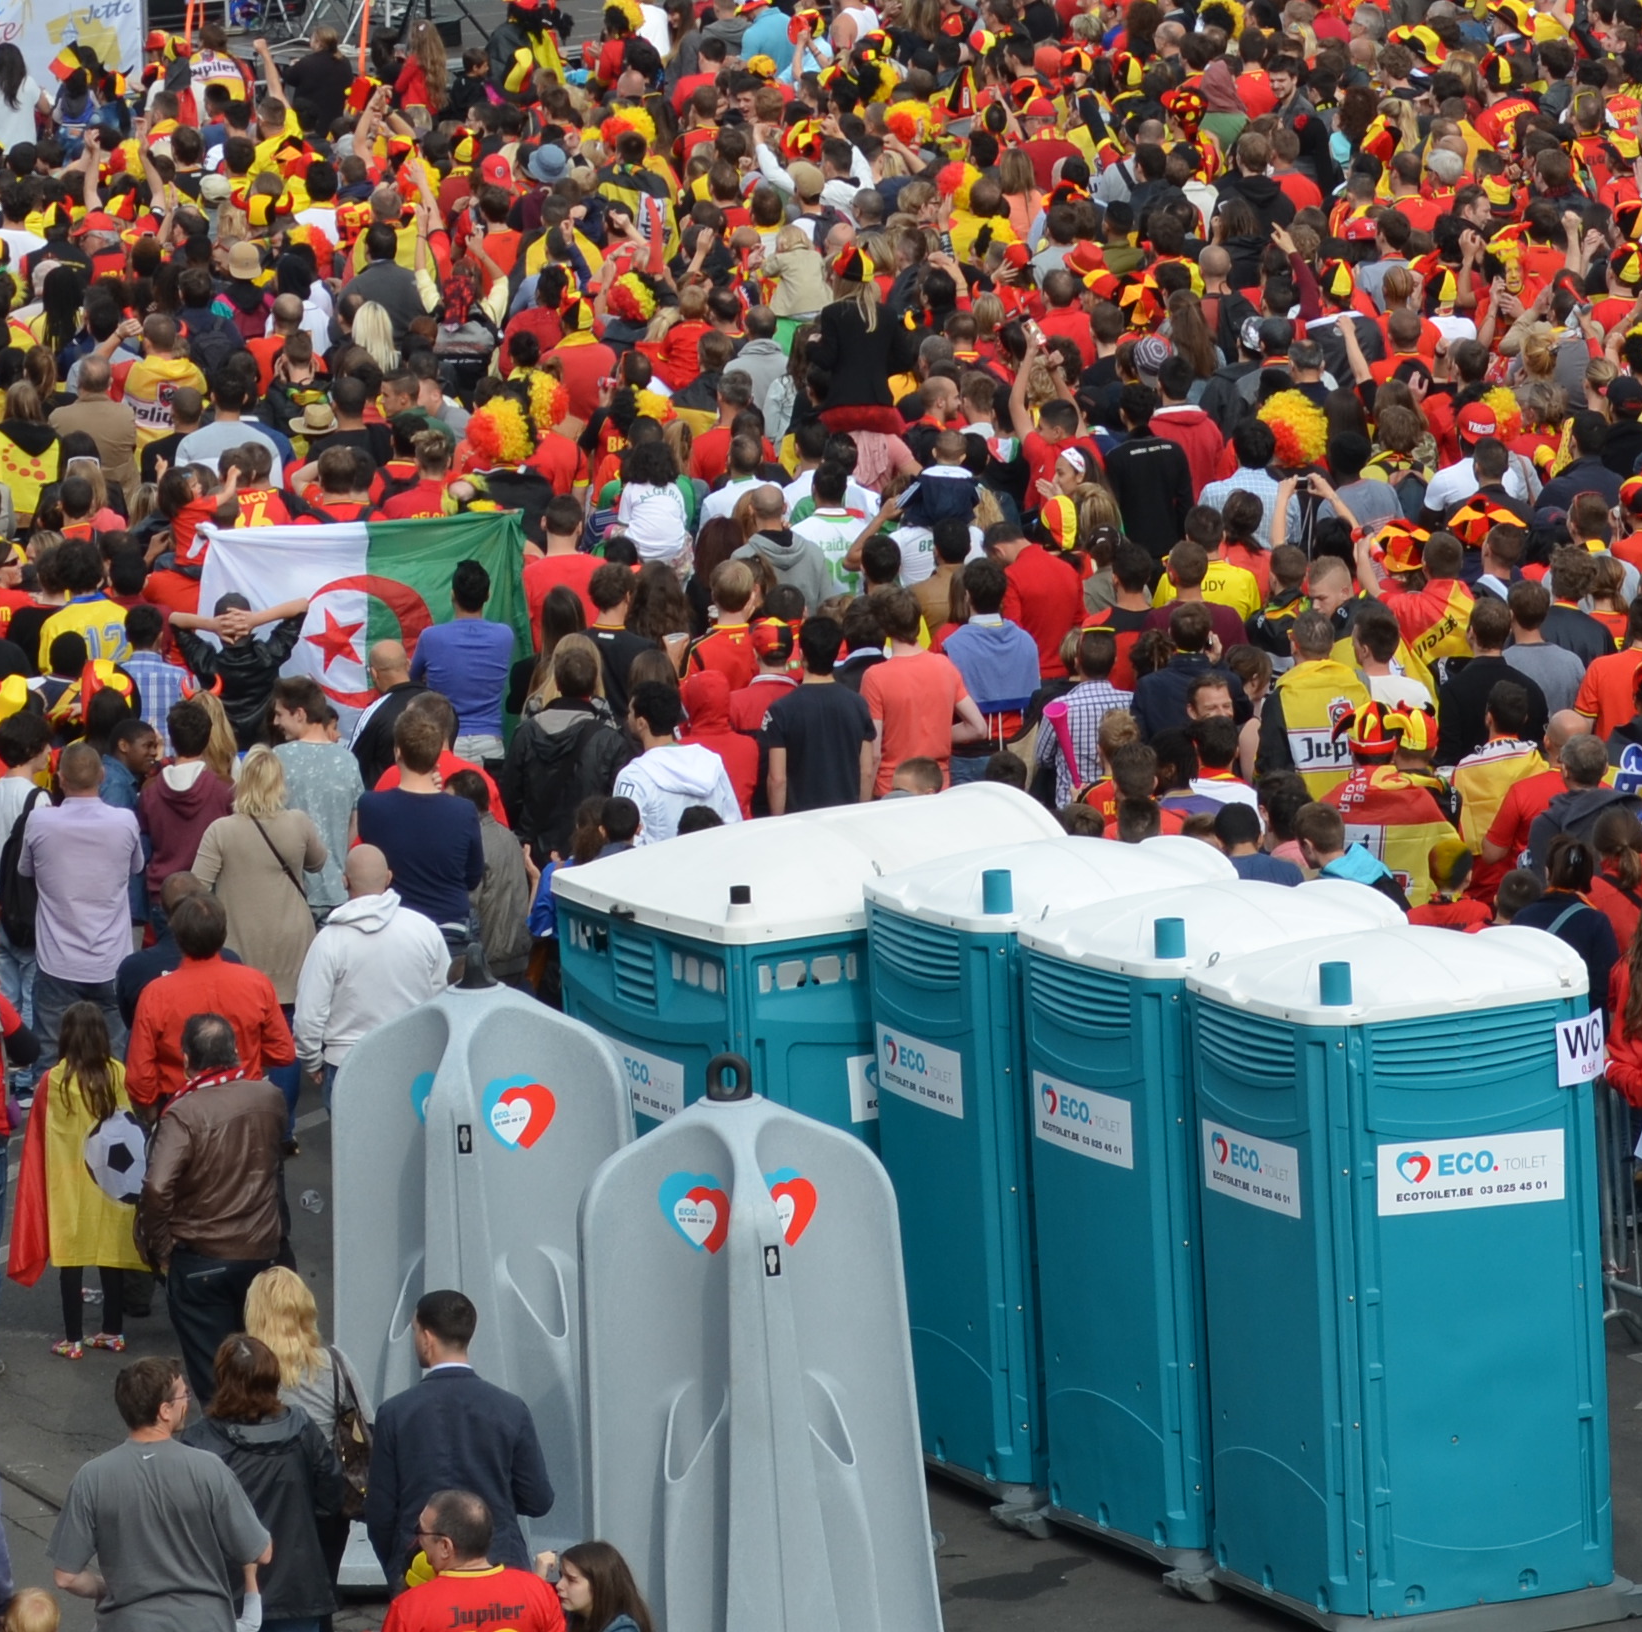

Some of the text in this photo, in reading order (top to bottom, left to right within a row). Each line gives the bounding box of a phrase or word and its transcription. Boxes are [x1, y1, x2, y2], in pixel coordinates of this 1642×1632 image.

[82, 2, 133, 25] Jette
[1564, 1018, 1601, 1059] WC
[885, 1070, 917, 1093] ECOTOILET.BE
[1042, 1120, 1079, 1143] ECOTOILET.BE
[1504, 1154, 1547, 1171] TOILET
[1212, 1169, 1249, 1192] ECOTOILET.BE
[1396, 1180, 1549, 1203] ECOTOILET.BE 03 825 45 01
[449, 1603, 525, 1628] Jupiler
